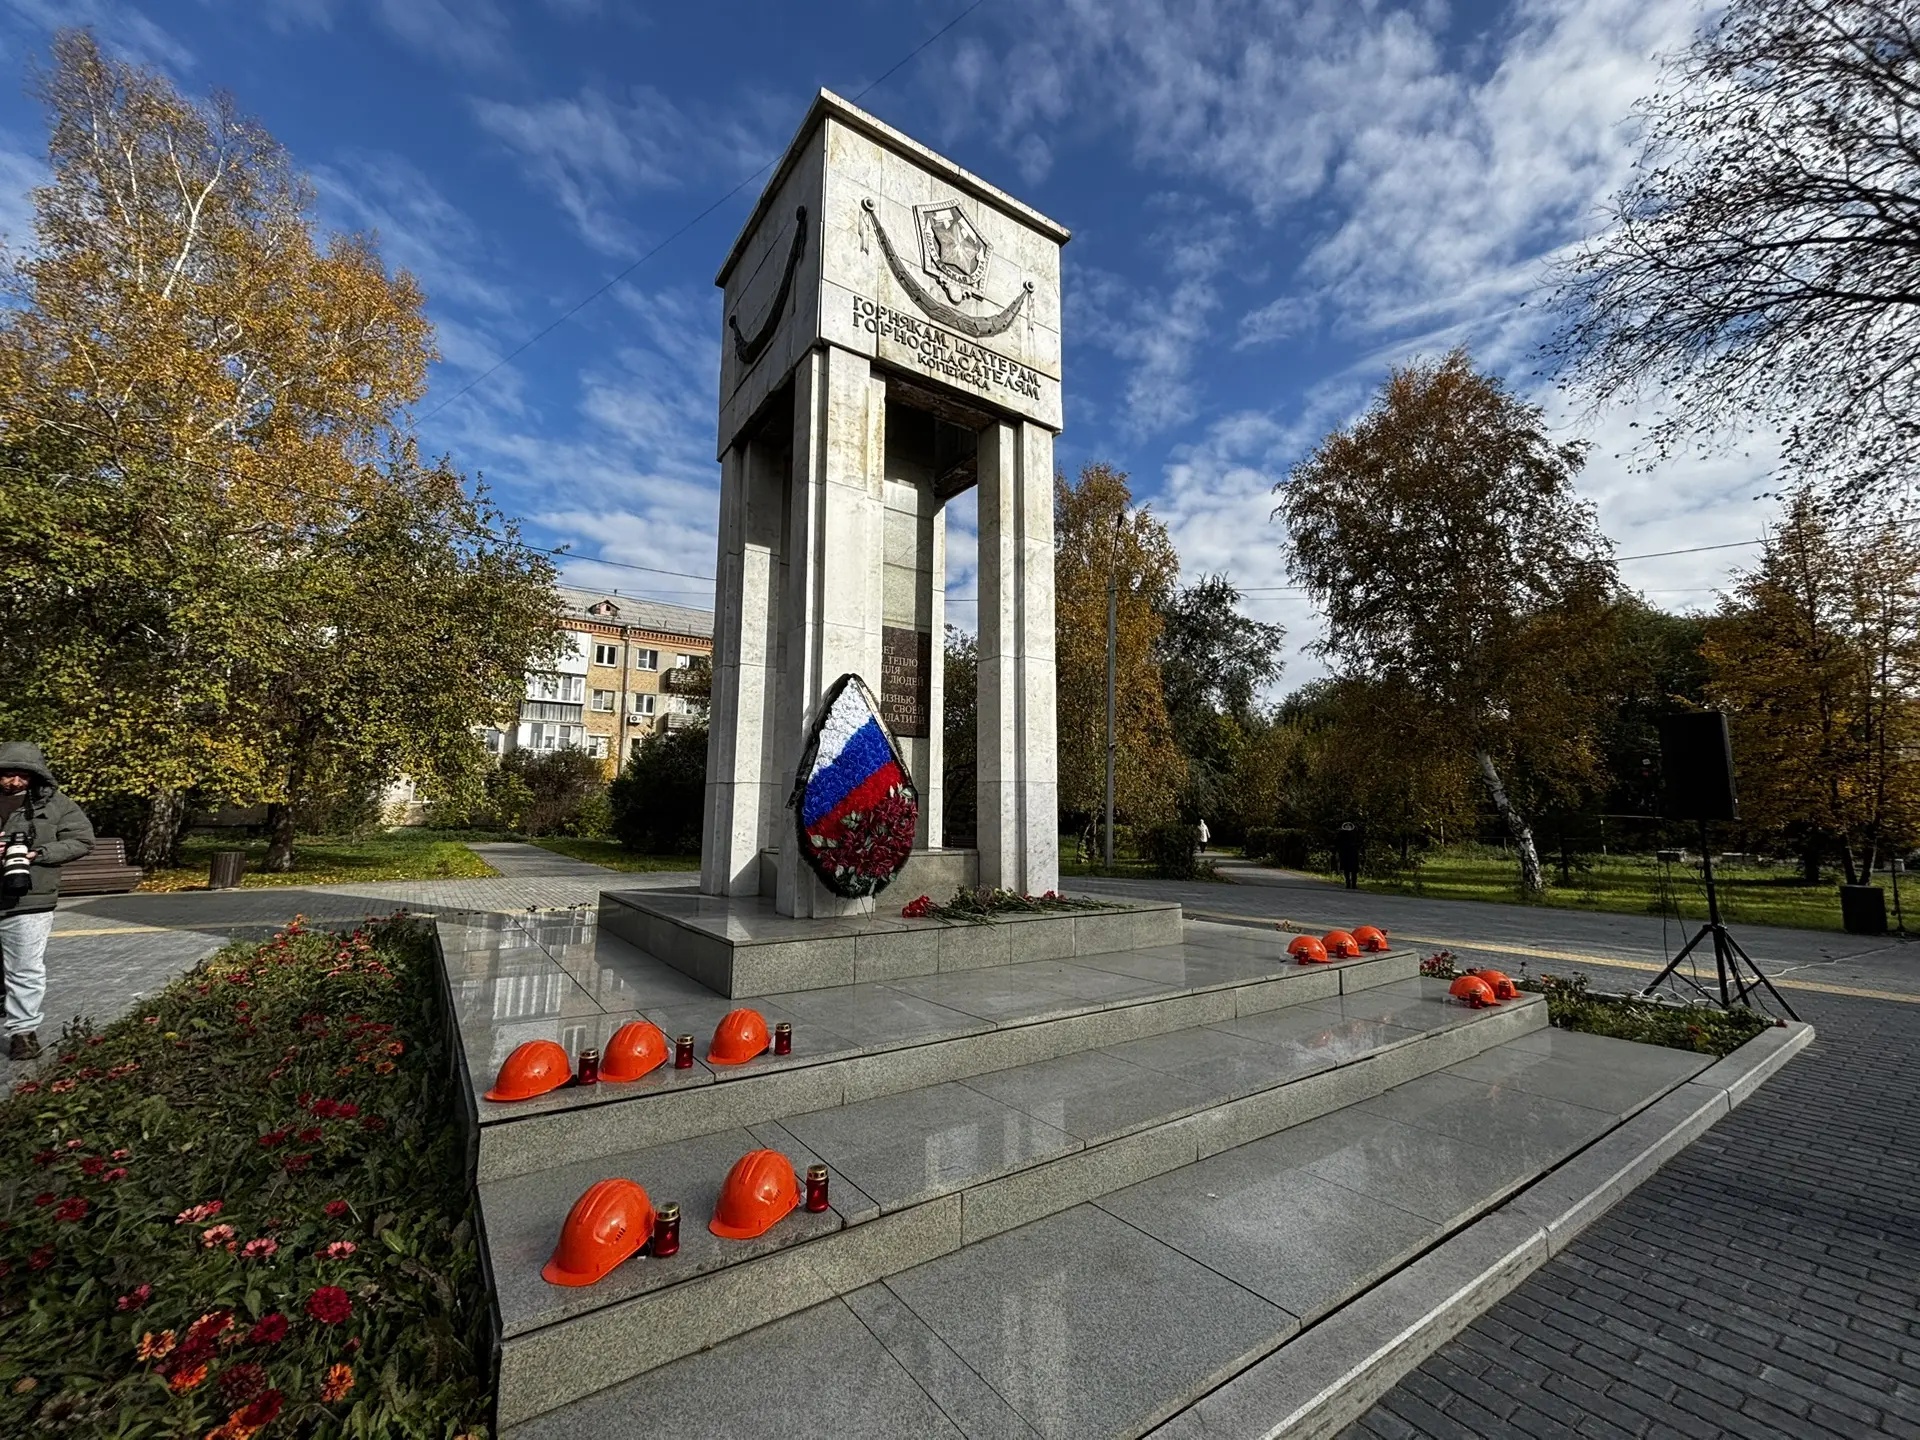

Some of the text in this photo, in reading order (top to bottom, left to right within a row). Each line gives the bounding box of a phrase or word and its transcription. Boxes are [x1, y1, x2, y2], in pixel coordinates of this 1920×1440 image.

[925, 231, 968, 283] ШАХТРСКАЯ
[853, 295, 1041, 388] ГОРНЯКАМ ШАХТЕРАМ
[853, 312, 1040, 400] ГОРНОСПАСАТЕЛЯМ
[917, 352, 990, 391] КОПЕЙСКА
[882, 645, 895, 655] ЕТ
[888, 656, 918, 667] ТЕПЛО
[890, 676, 924, 686] ЛЮДЕЙ
[881, 693, 916, 705] ИЗНЬЮ
[893, 704, 924, 715] СВОЕЙ
